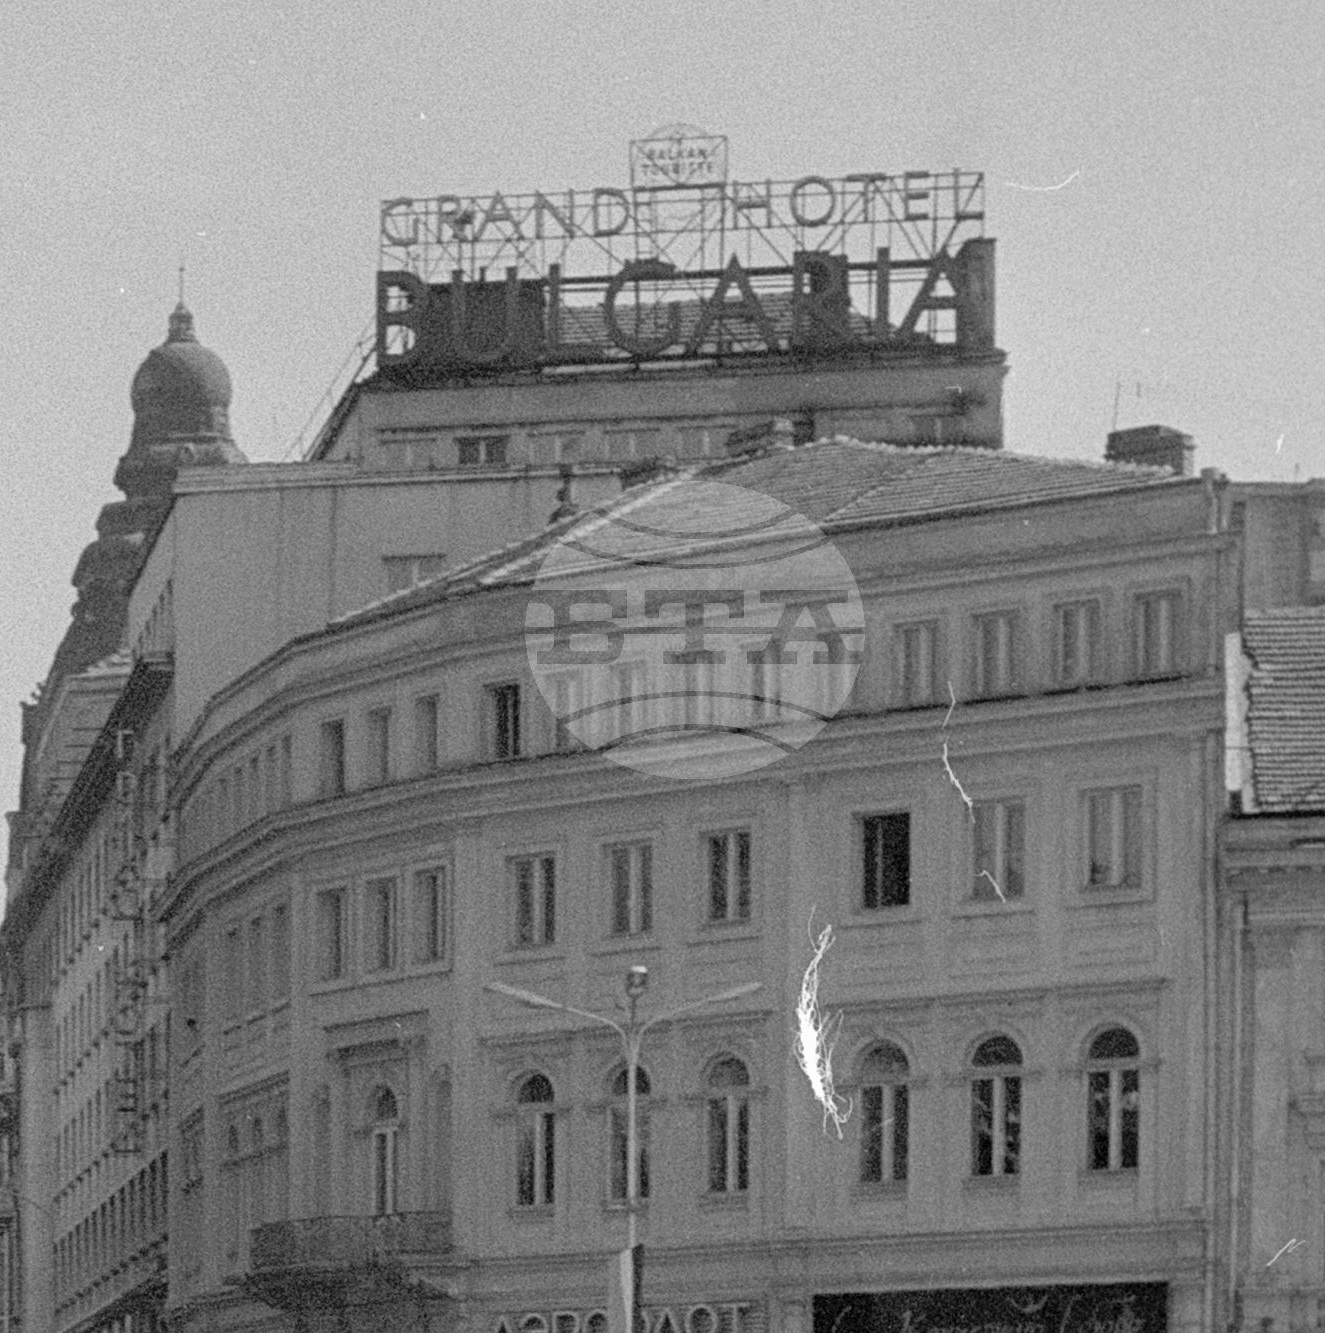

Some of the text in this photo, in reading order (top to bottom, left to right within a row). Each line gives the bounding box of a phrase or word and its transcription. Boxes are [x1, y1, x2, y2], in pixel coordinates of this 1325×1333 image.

[381, 171, 986, 247] GRAND HOTEL
[376, 240, 995, 369] BULGARIA
